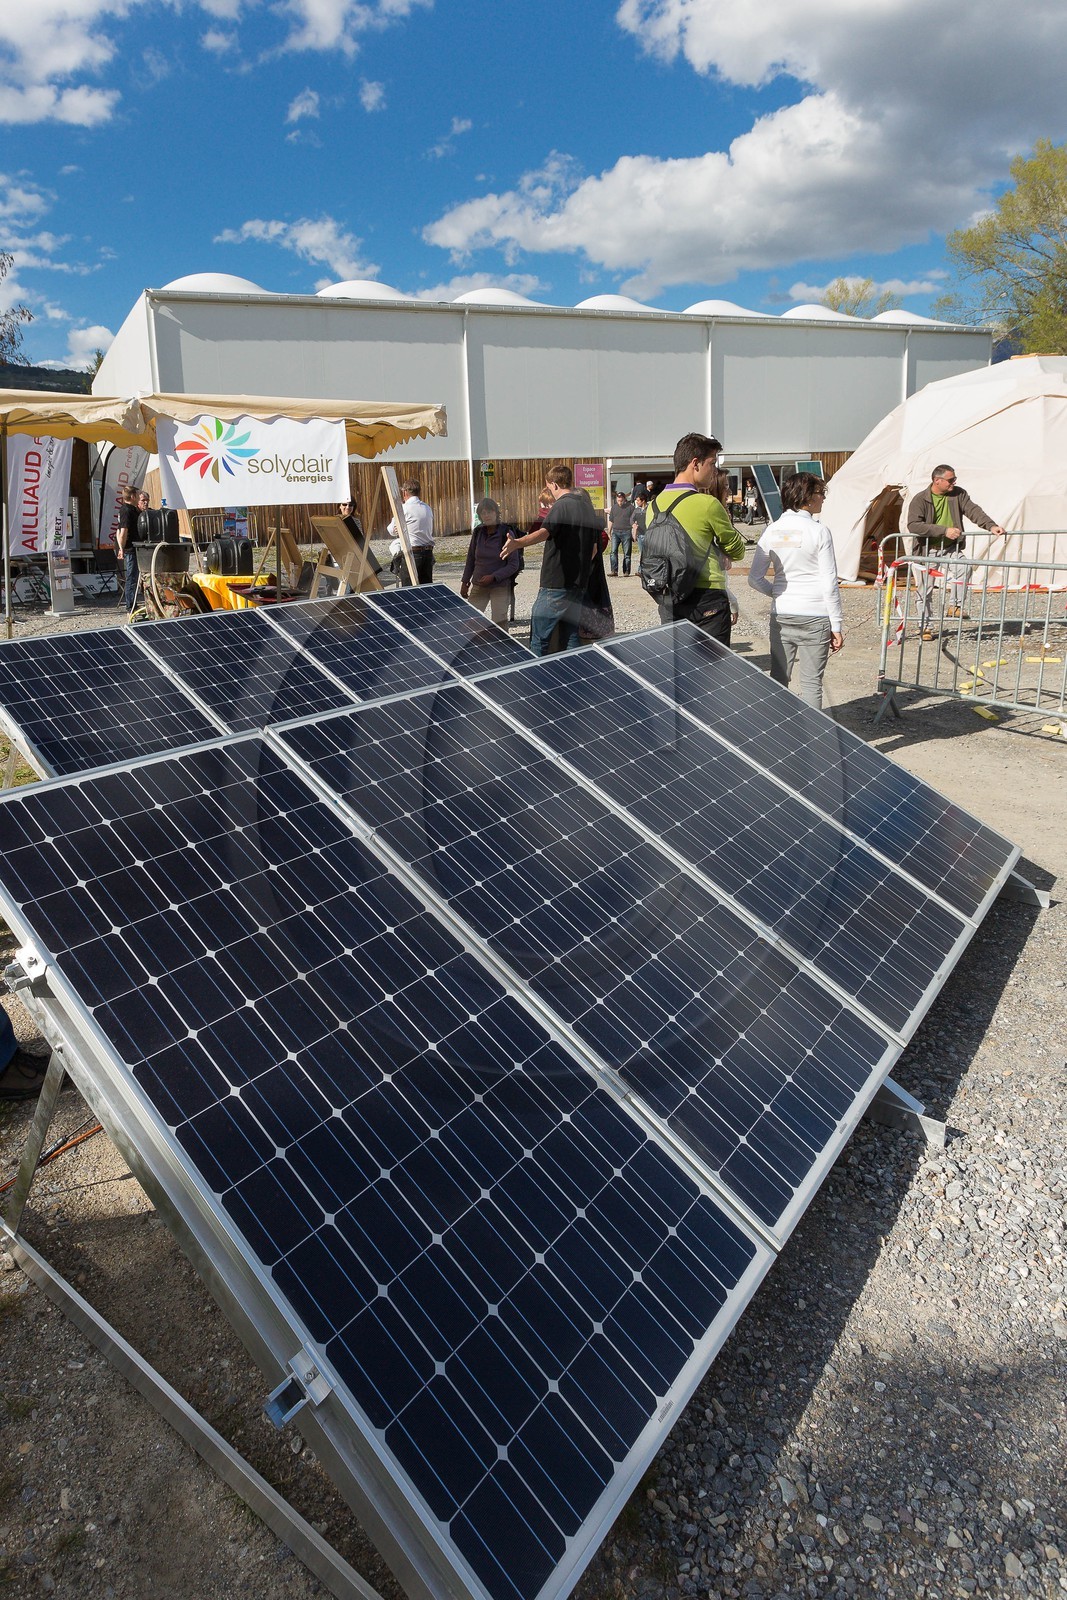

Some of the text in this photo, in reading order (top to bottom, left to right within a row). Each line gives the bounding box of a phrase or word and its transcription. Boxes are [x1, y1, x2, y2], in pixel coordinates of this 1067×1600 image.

[247, 454, 333, 477] solydair
[286, 474, 333, 483] énergies
[21, 450, 43, 552] AILLIAUD
